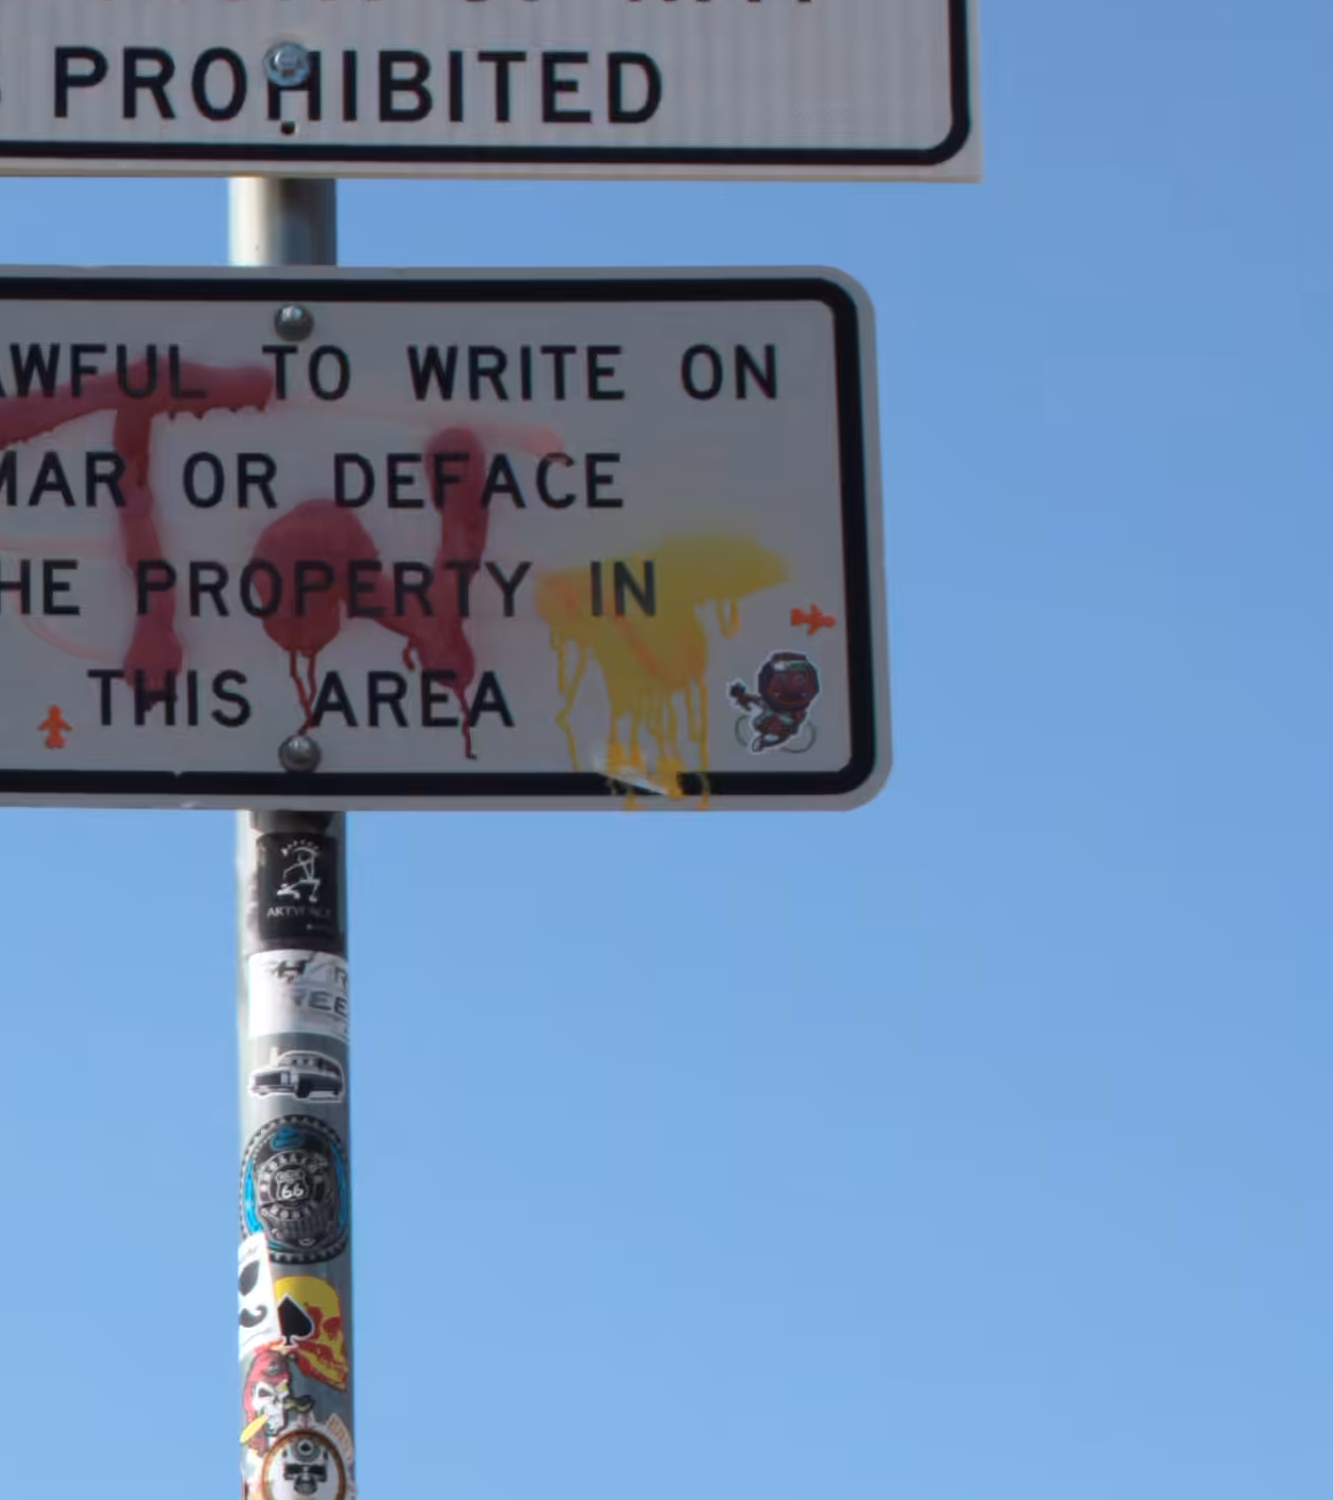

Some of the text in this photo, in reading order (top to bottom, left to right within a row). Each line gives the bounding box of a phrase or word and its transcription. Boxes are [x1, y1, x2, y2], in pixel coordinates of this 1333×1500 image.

[54, 46, 662, 124] PROHIBITED
[261, 345, 350, 401] TO
[408, 344, 625, 401] WRITE
[682, 344, 779, 400] ON
[183, 452, 277, 509] OR
[334, 452, 624, 509] DEFACE
[137, 560, 532, 618] PROPERTY
[590, 561, 658, 617] IN
[88, 669, 515, 728] THIS AREA
[282, 1184, 304, 1199] 66
